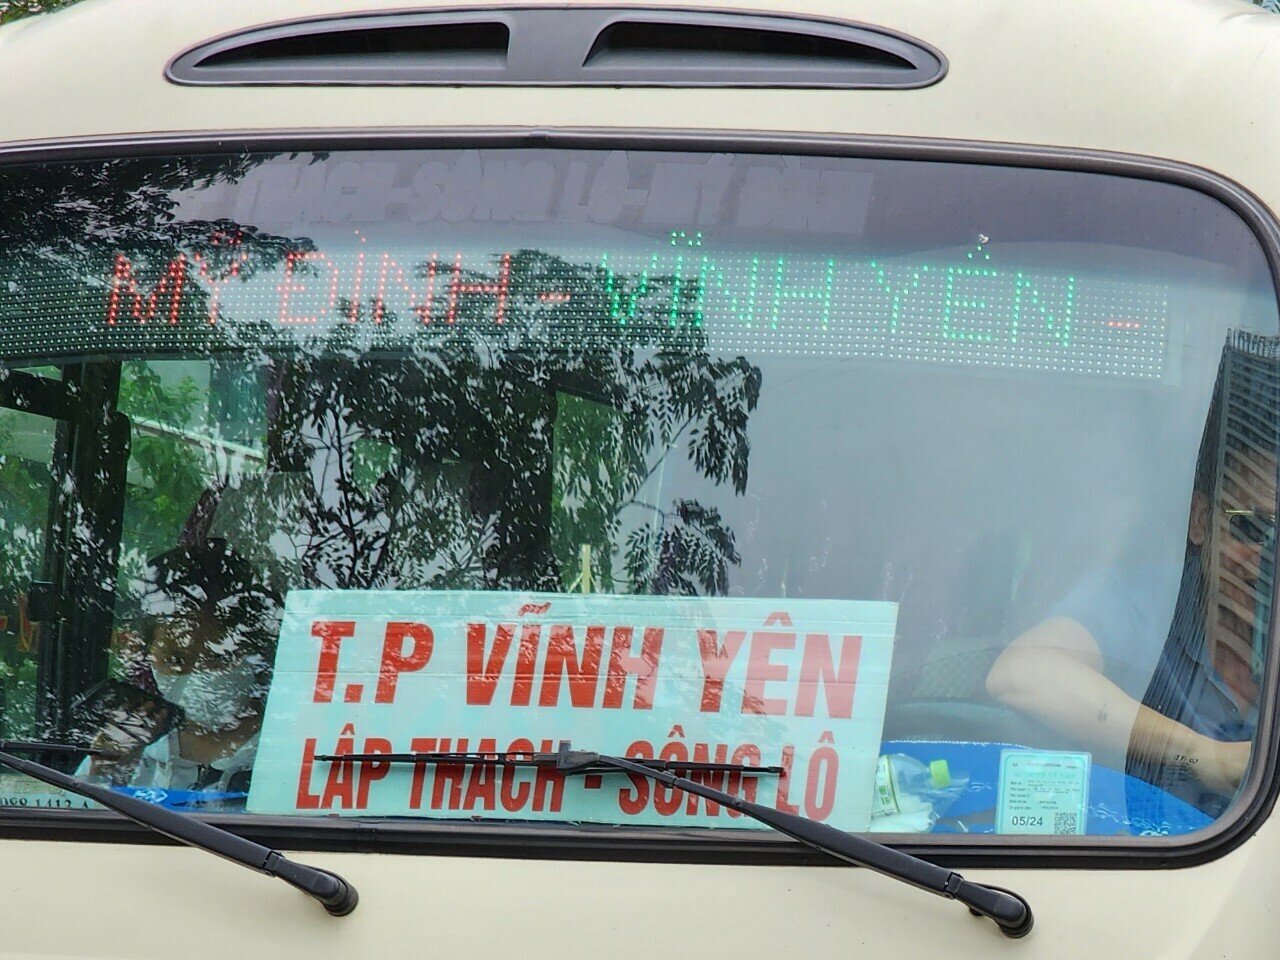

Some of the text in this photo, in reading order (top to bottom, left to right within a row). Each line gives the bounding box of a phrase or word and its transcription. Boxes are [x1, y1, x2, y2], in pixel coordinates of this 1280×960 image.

[310, 601, 865, 720] T.P VĨNH YÊN
[1011, 815, 1044, 827] 05/24
